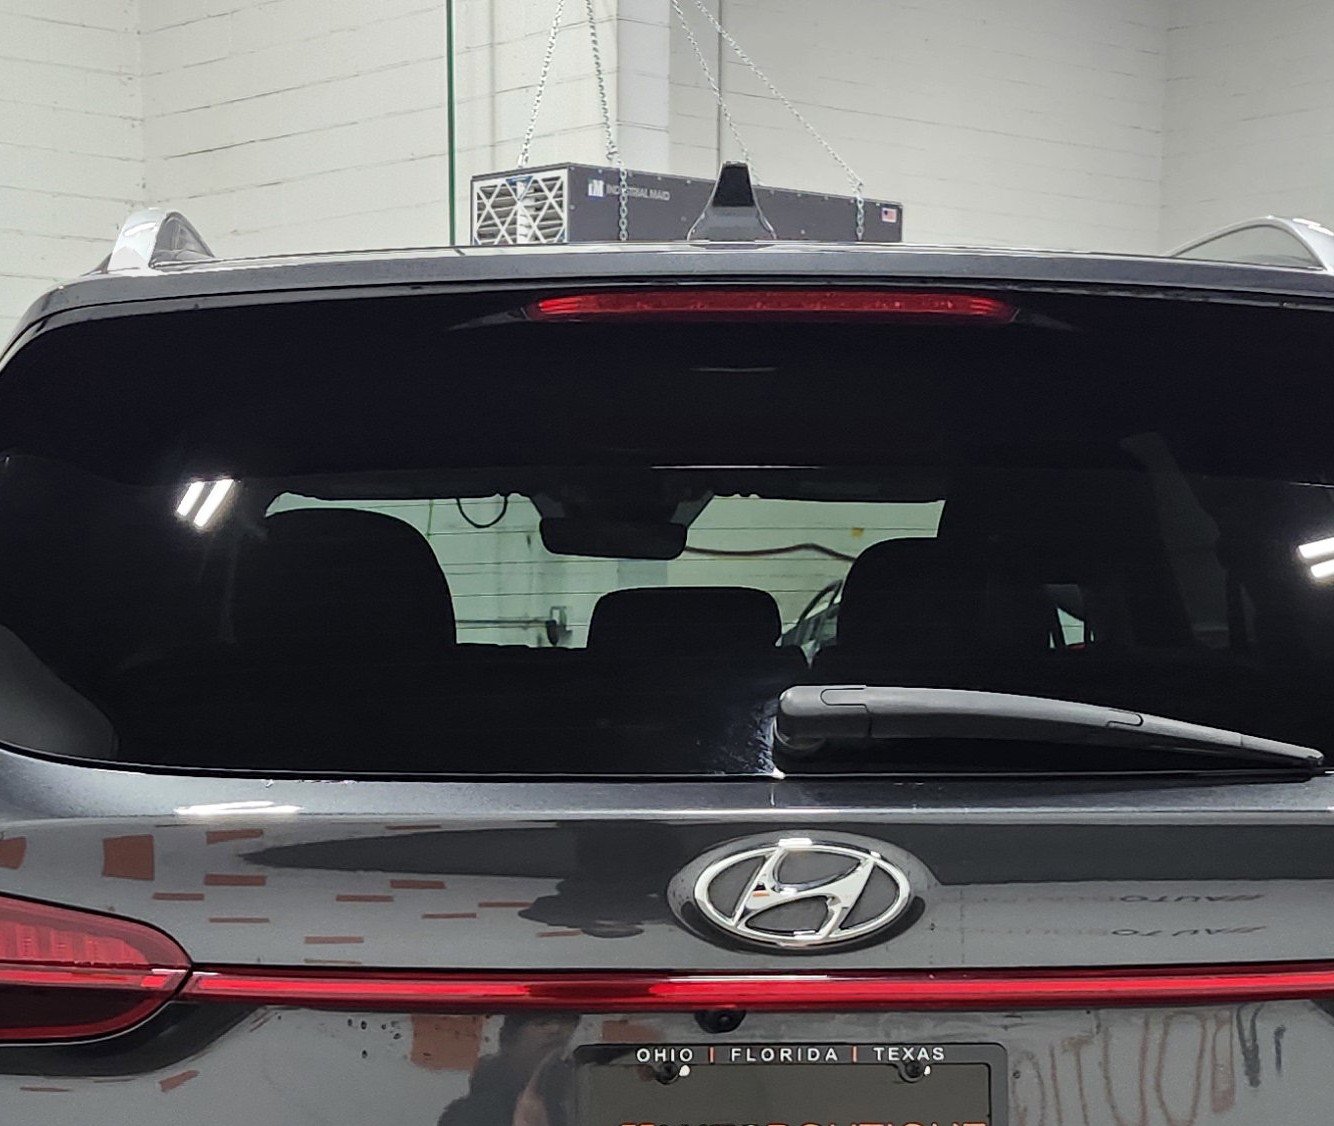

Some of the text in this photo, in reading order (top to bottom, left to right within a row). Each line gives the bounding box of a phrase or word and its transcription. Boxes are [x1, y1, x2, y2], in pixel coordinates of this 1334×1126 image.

[635, 1046, 945, 1063] OHIO FLORIDA TEXAS
